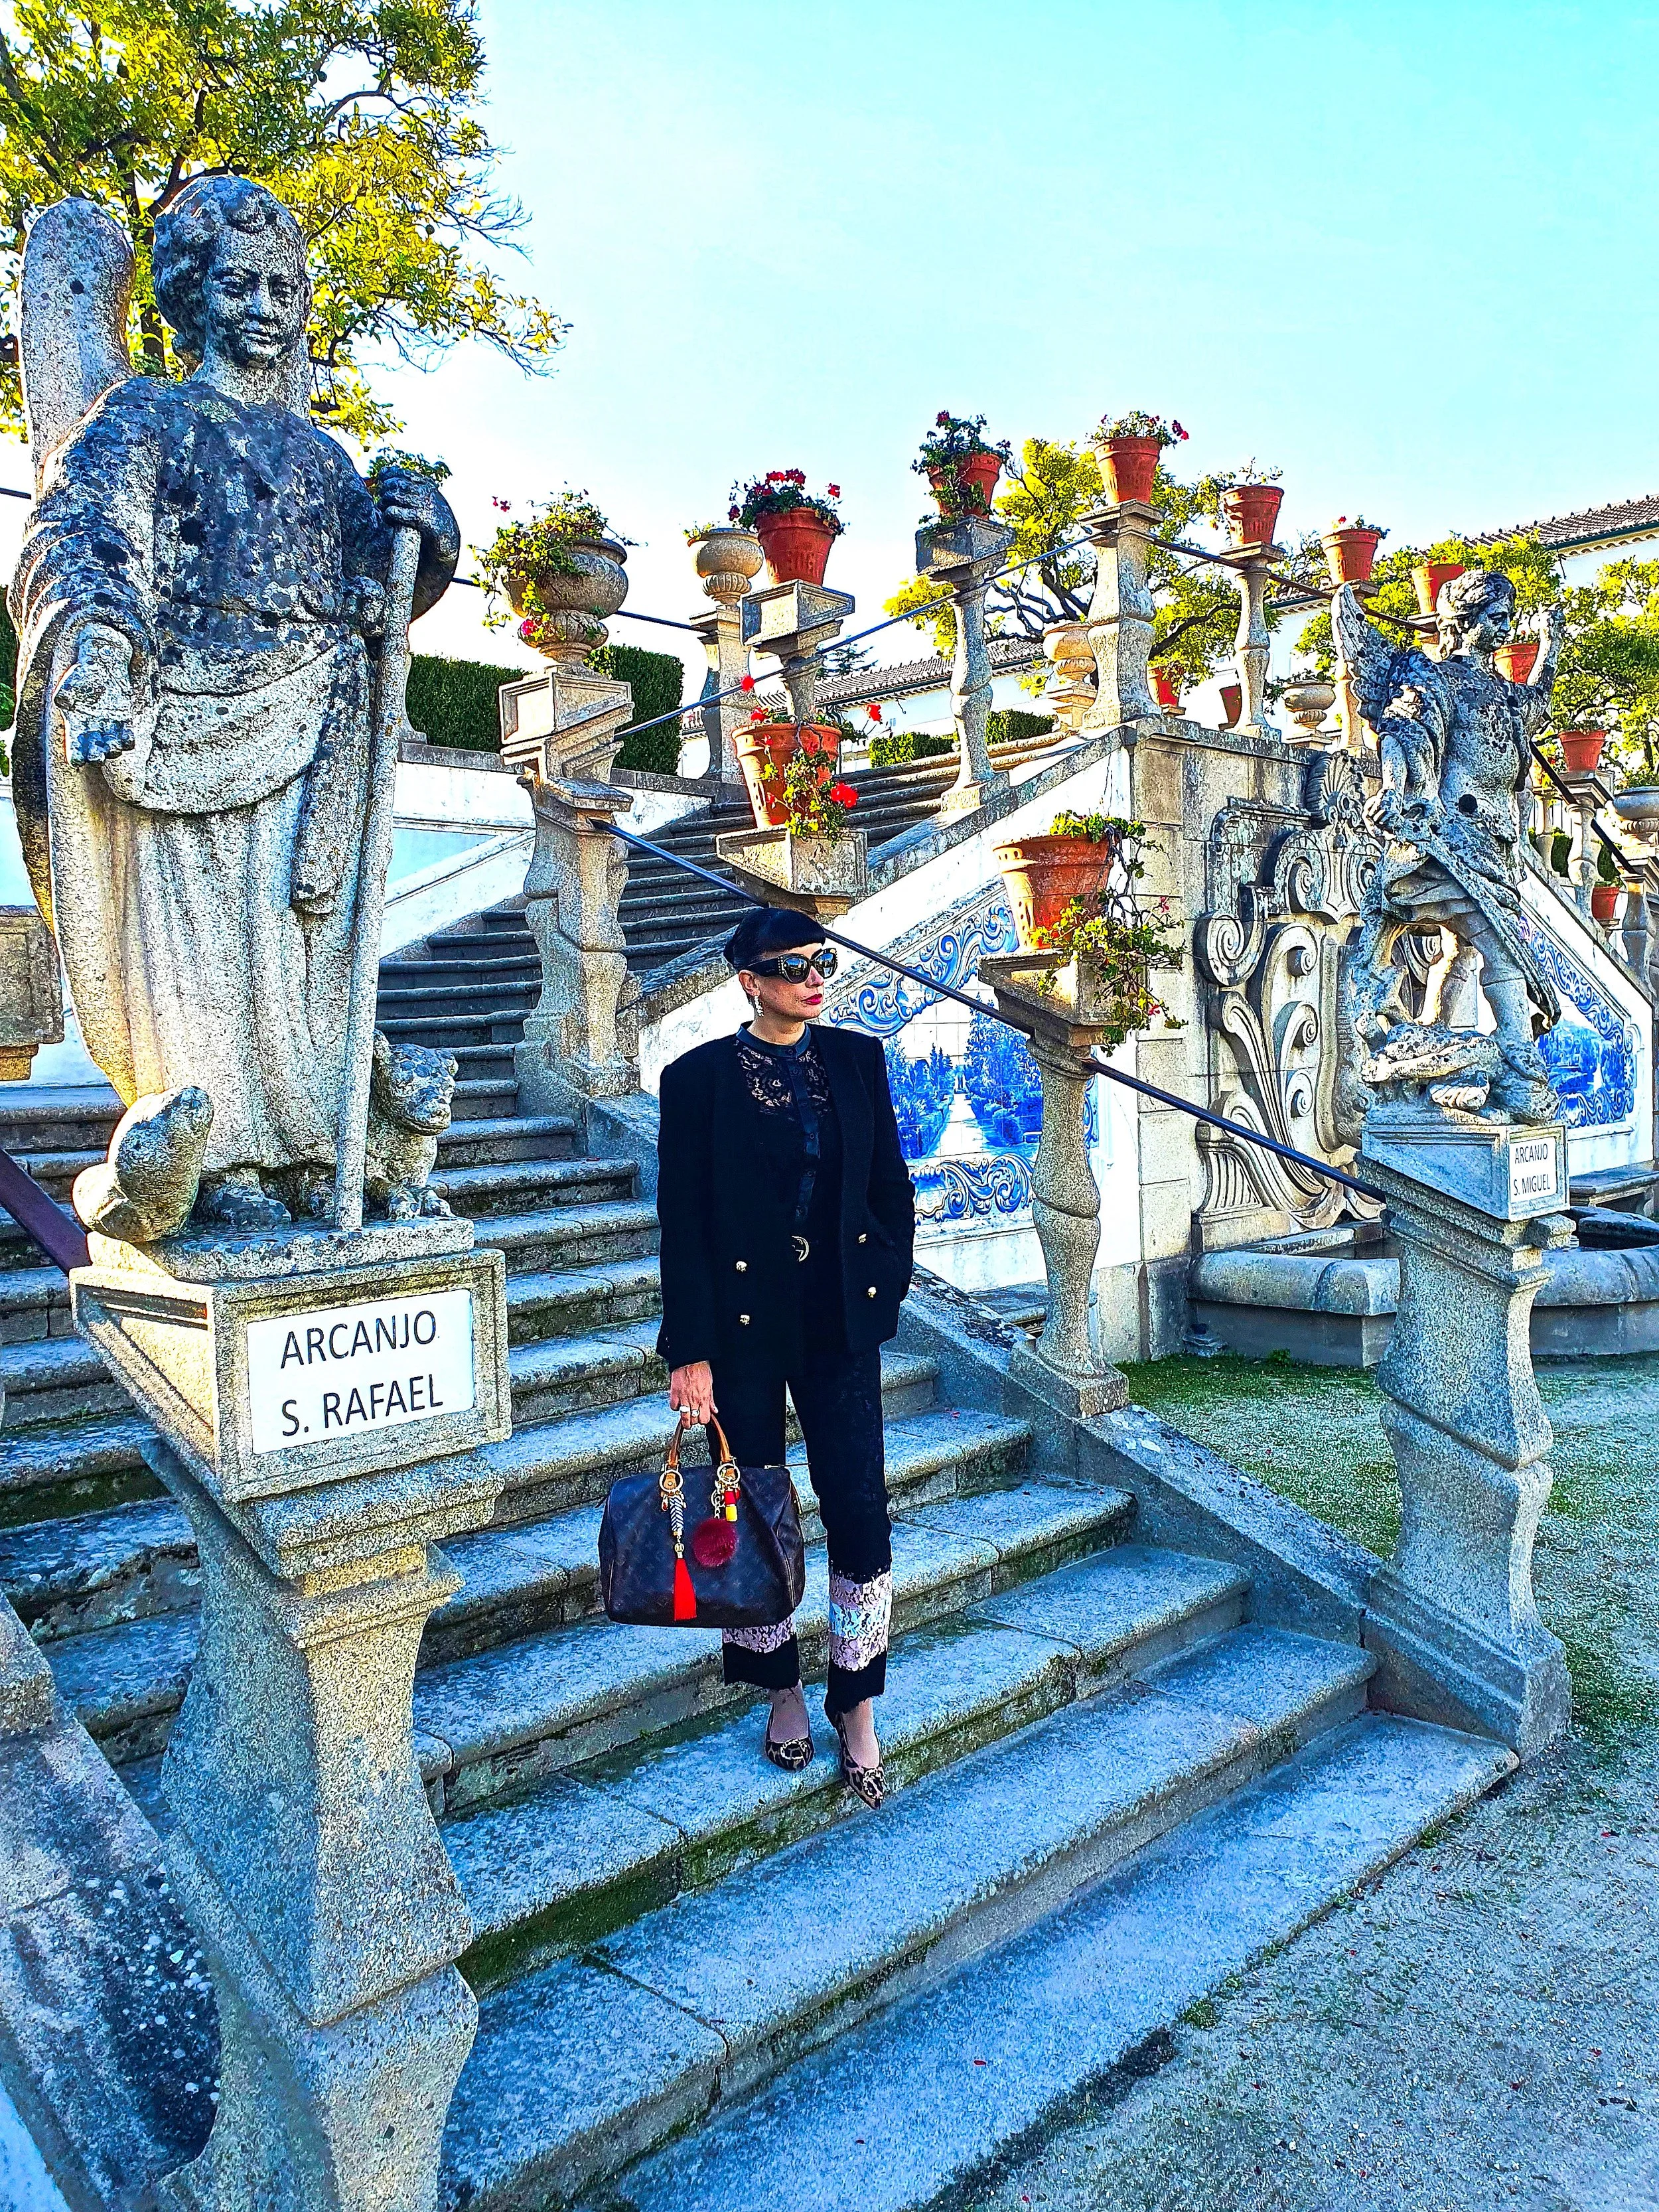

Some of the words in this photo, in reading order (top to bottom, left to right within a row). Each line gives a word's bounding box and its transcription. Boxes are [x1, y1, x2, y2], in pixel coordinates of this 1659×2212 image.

[1514, 1143, 1548, 1164] ARCANJO
[1513, 1179, 1520, 1196] S.
[1522, 1173, 1551, 1194] MIGUEL
[280, 1310, 437, 1369] ARCANJO
[281, 1399, 309, 1437] S.
[323, 1374, 443, 1429] RAFAEL
